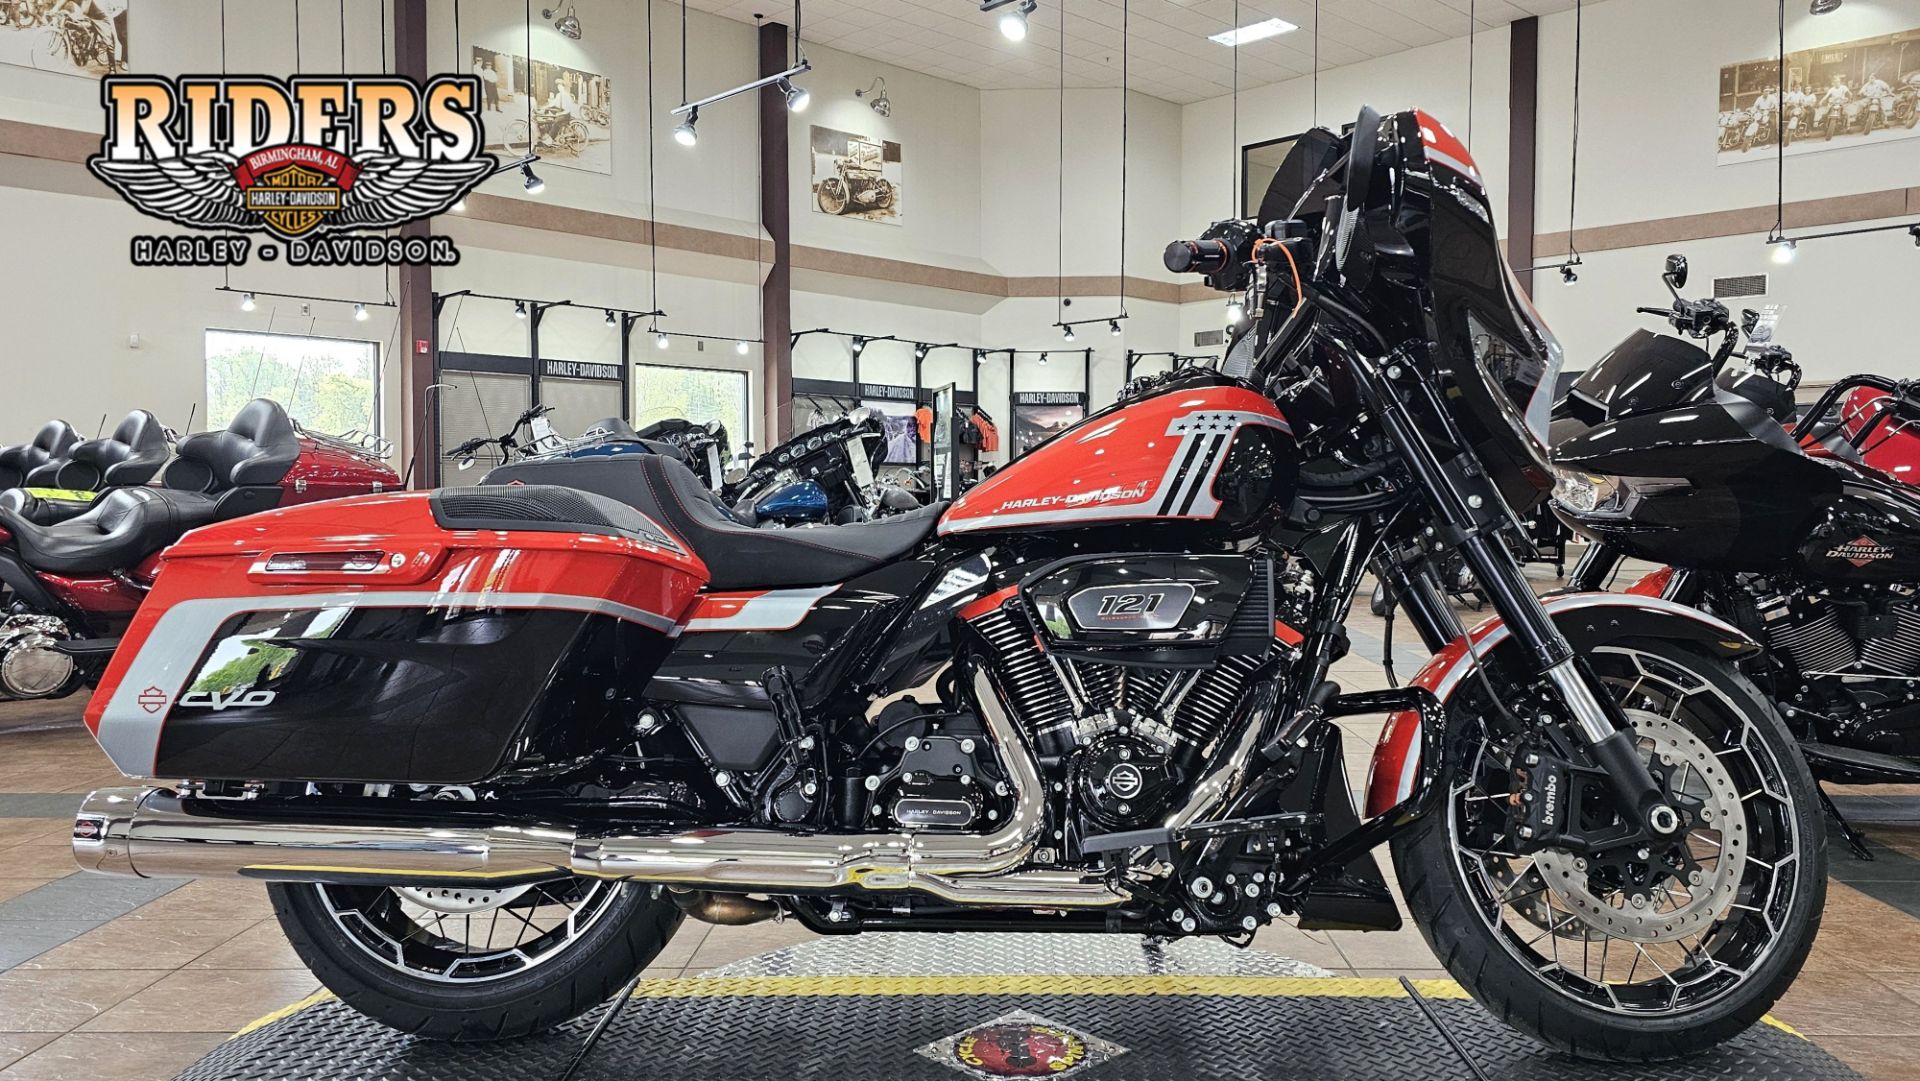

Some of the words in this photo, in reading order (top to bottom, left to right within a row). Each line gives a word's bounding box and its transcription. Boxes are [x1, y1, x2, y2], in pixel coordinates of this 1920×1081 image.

[546, 360, 619, 379] HARLEY-DAVIDSON
[1019, 392, 1080, 404] HARLEY-DAVIDSON
[1825, 550, 1894, 559] DAVIDSON
[1097, 593, 1165, 615] 121
[178, 688, 277, 711] CVO
[1541, 774, 1557, 826] brembo
